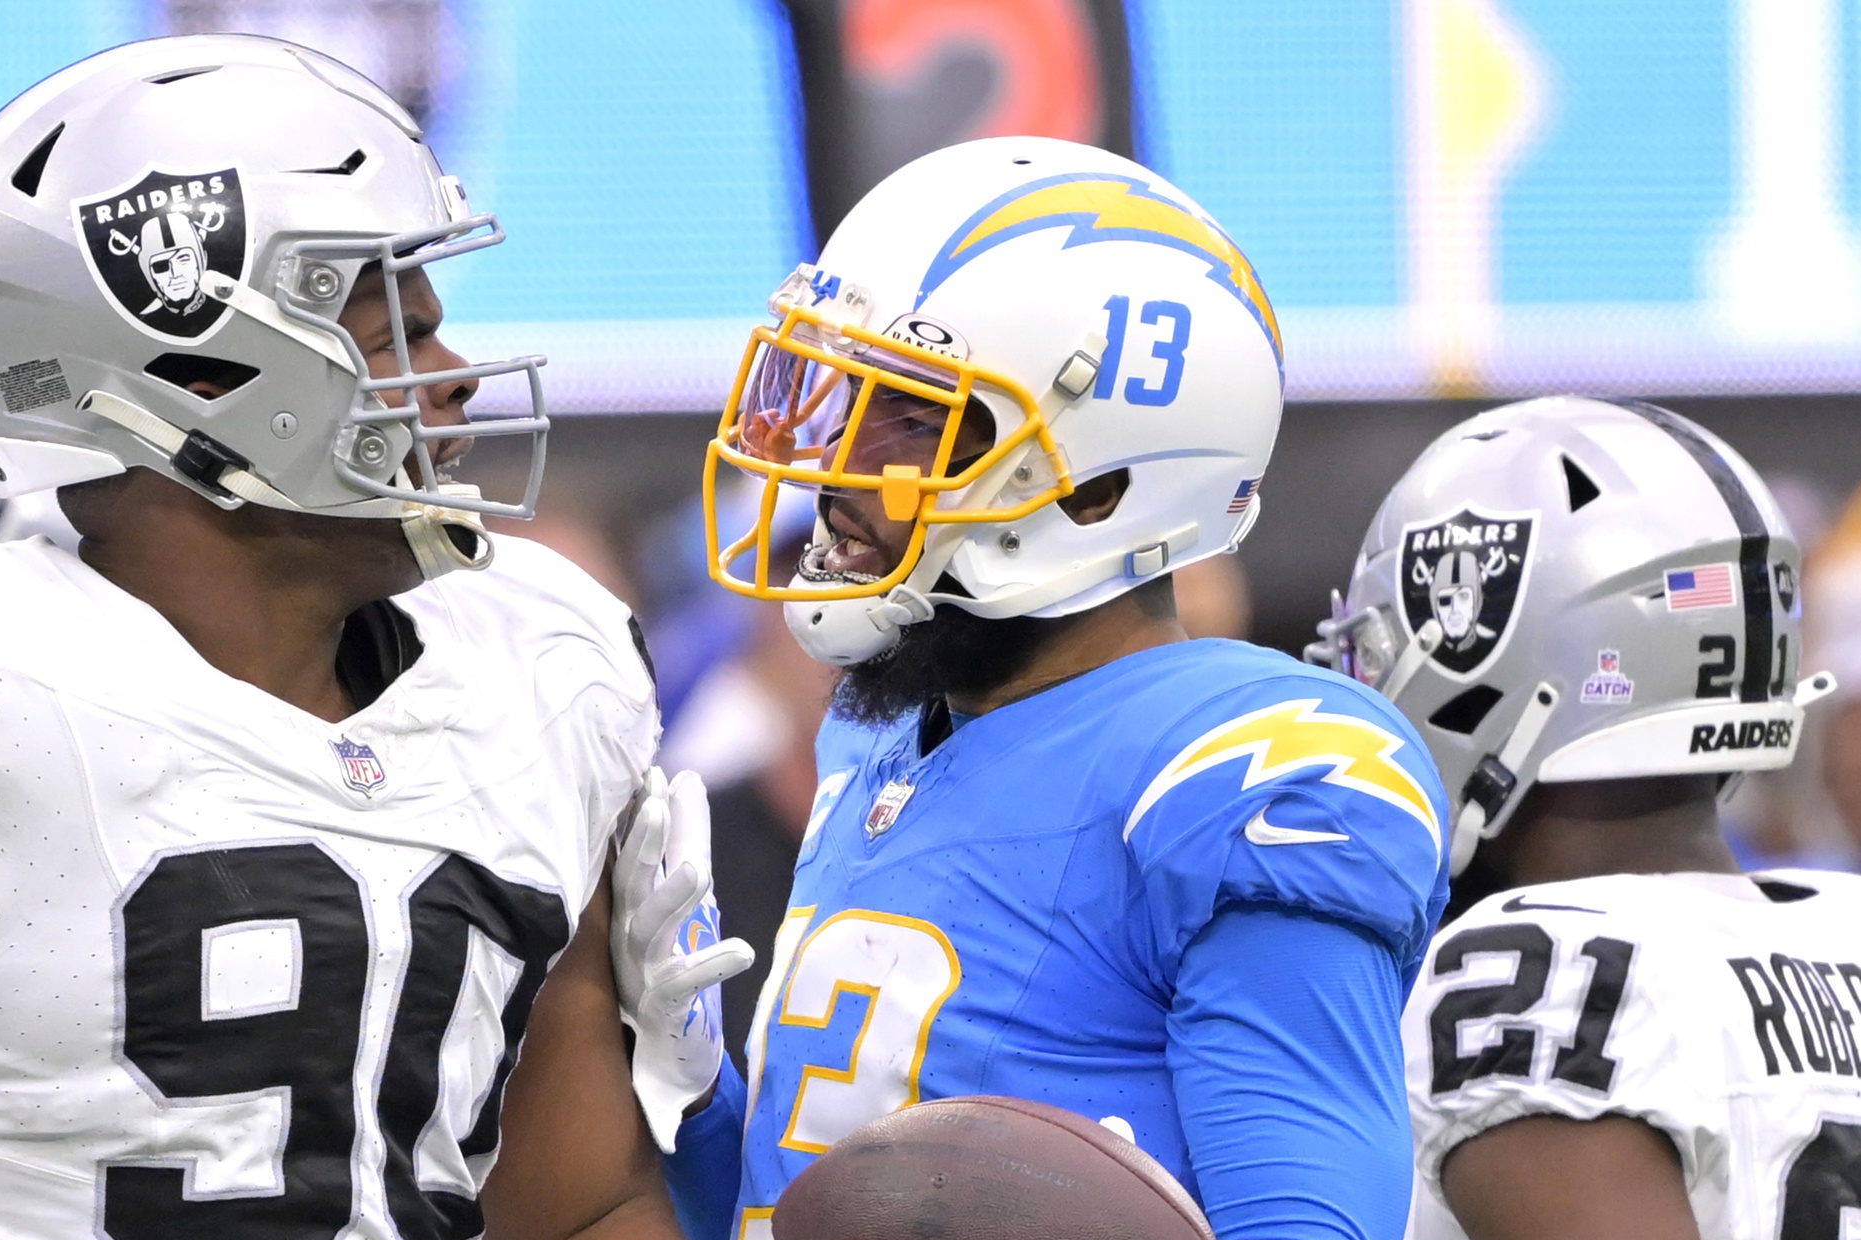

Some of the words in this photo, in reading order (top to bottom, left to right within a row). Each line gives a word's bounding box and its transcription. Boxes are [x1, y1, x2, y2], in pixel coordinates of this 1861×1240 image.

[95, 175, 226, 225] RAIDERS
[1092, 294, 1192, 407] 13
[1412, 522, 1518, 552] RAIDERS
[1584, 682, 1632, 696] CATCH
[1689, 719, 1794, 755] RAIDERS
[347, 759, 382, 784] NFL
[1428, 922, 1637, 1096] 21
